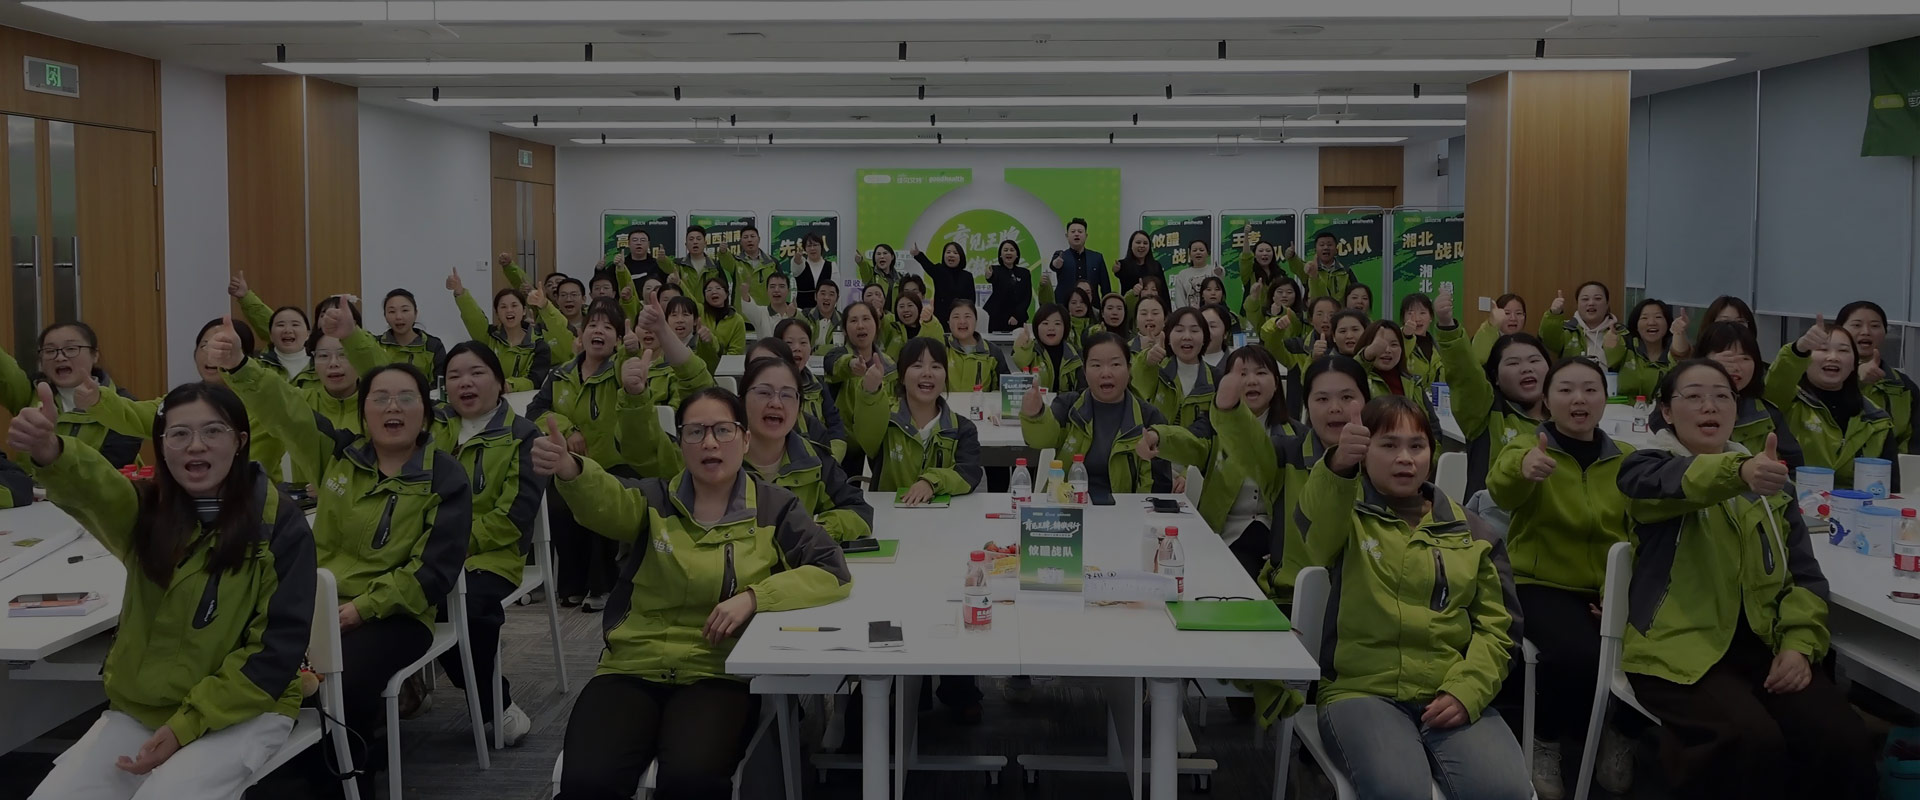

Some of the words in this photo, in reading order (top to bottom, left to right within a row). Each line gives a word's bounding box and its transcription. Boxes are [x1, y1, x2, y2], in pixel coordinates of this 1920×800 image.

[1402, 231, 1434, 249] 湘北
[1172, 247, 1191, 265] 战
[1419, 264, 1433, 293] 湘北
